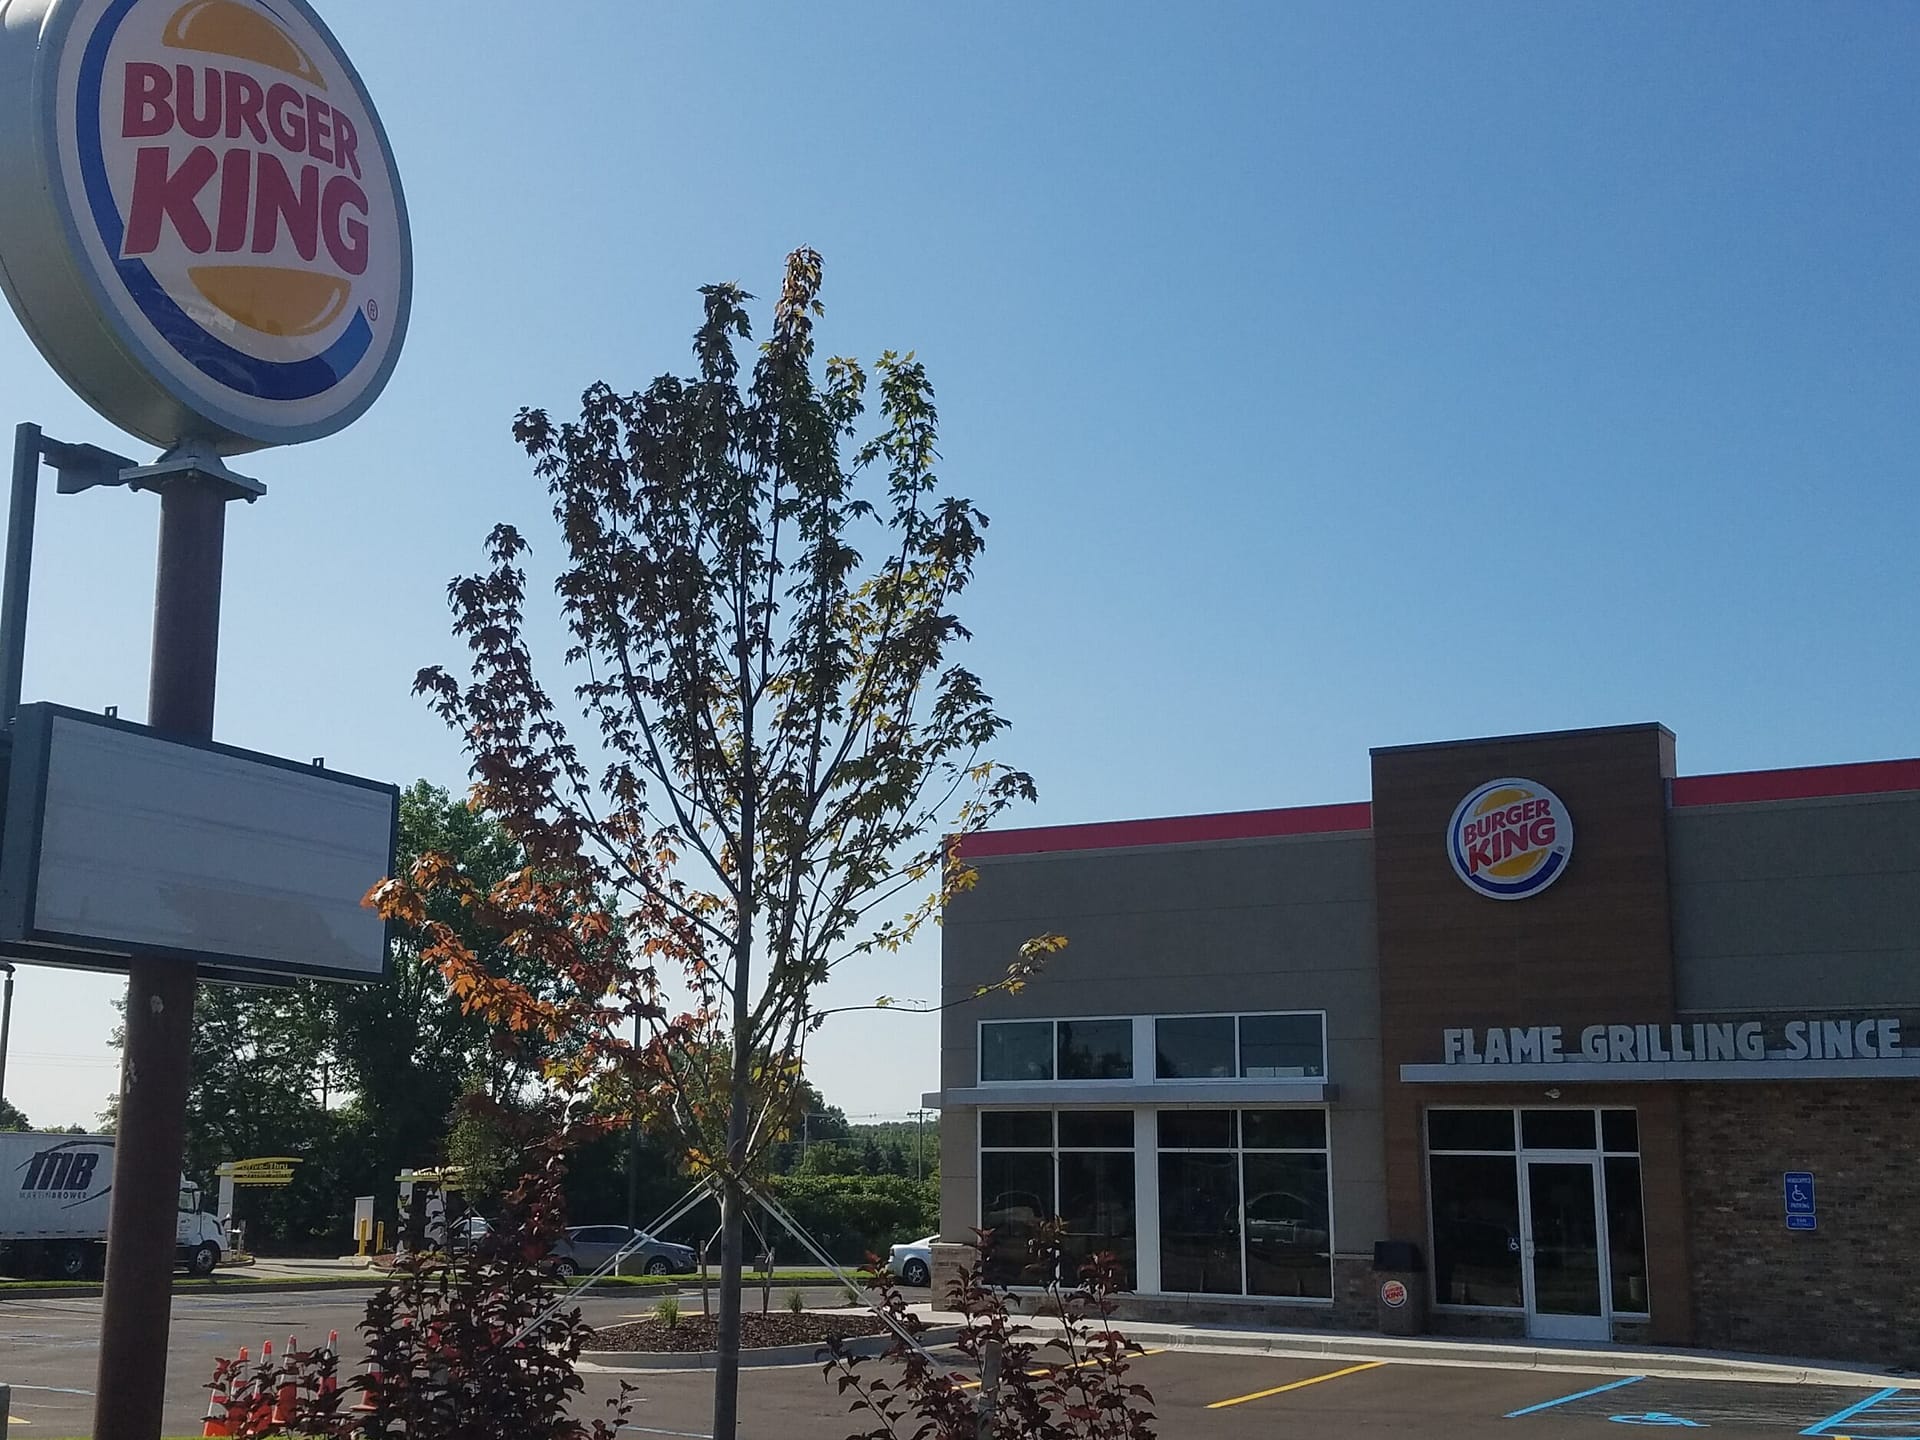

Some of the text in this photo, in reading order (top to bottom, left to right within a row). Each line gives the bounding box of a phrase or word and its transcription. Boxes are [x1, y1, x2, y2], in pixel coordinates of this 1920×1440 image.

[121, 61, 362, 181] BURGER
[123, 145, 370, 276] KING
[1463, 798, 1552, 847] BURGER
[1468, 817, 1556, 875] KING
[1443, 1018, 1904, 1064] FLAME GRILLING SINCE
[21, 1151, 99, 1191] MB
